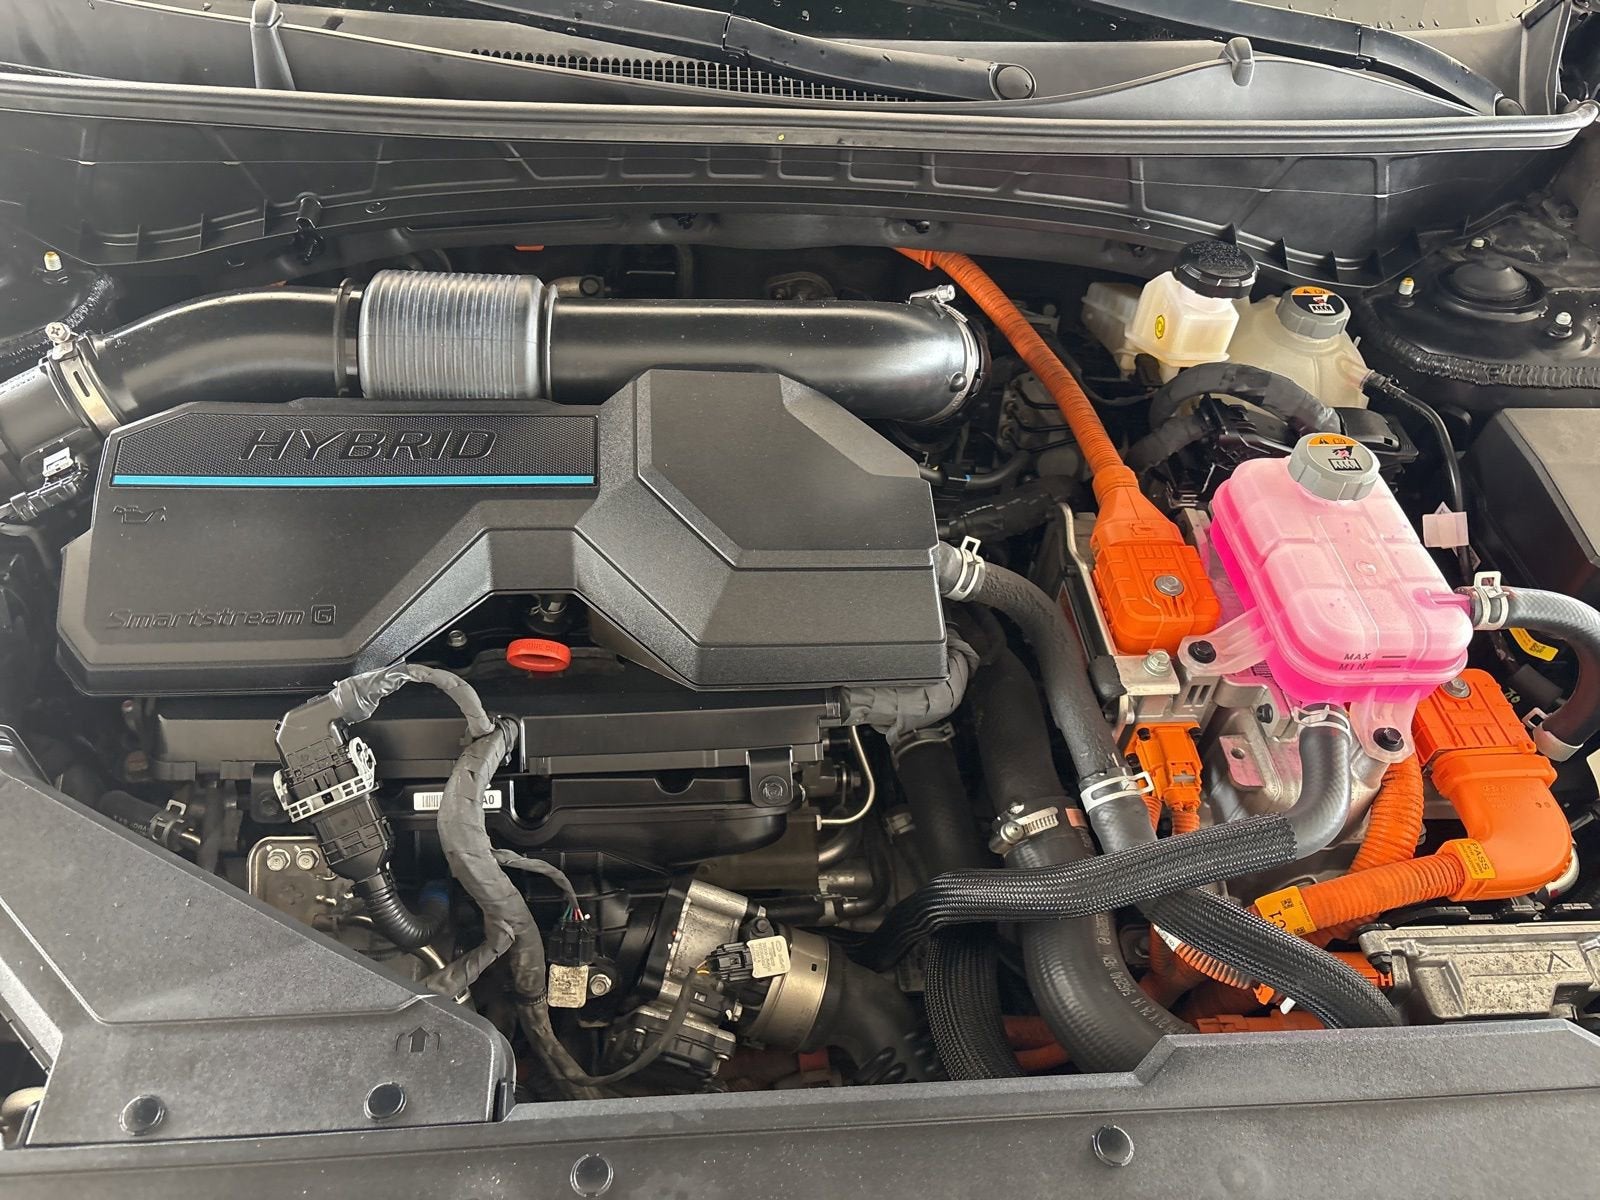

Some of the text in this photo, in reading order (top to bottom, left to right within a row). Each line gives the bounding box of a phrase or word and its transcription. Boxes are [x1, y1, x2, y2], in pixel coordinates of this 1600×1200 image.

[238, 429, 498, 461] HYBRID
[105, 608, 306, 629] Smartstream
[1339, 662, 1366, 671] MIN
[1471, 842, 1490, 870] PASS
